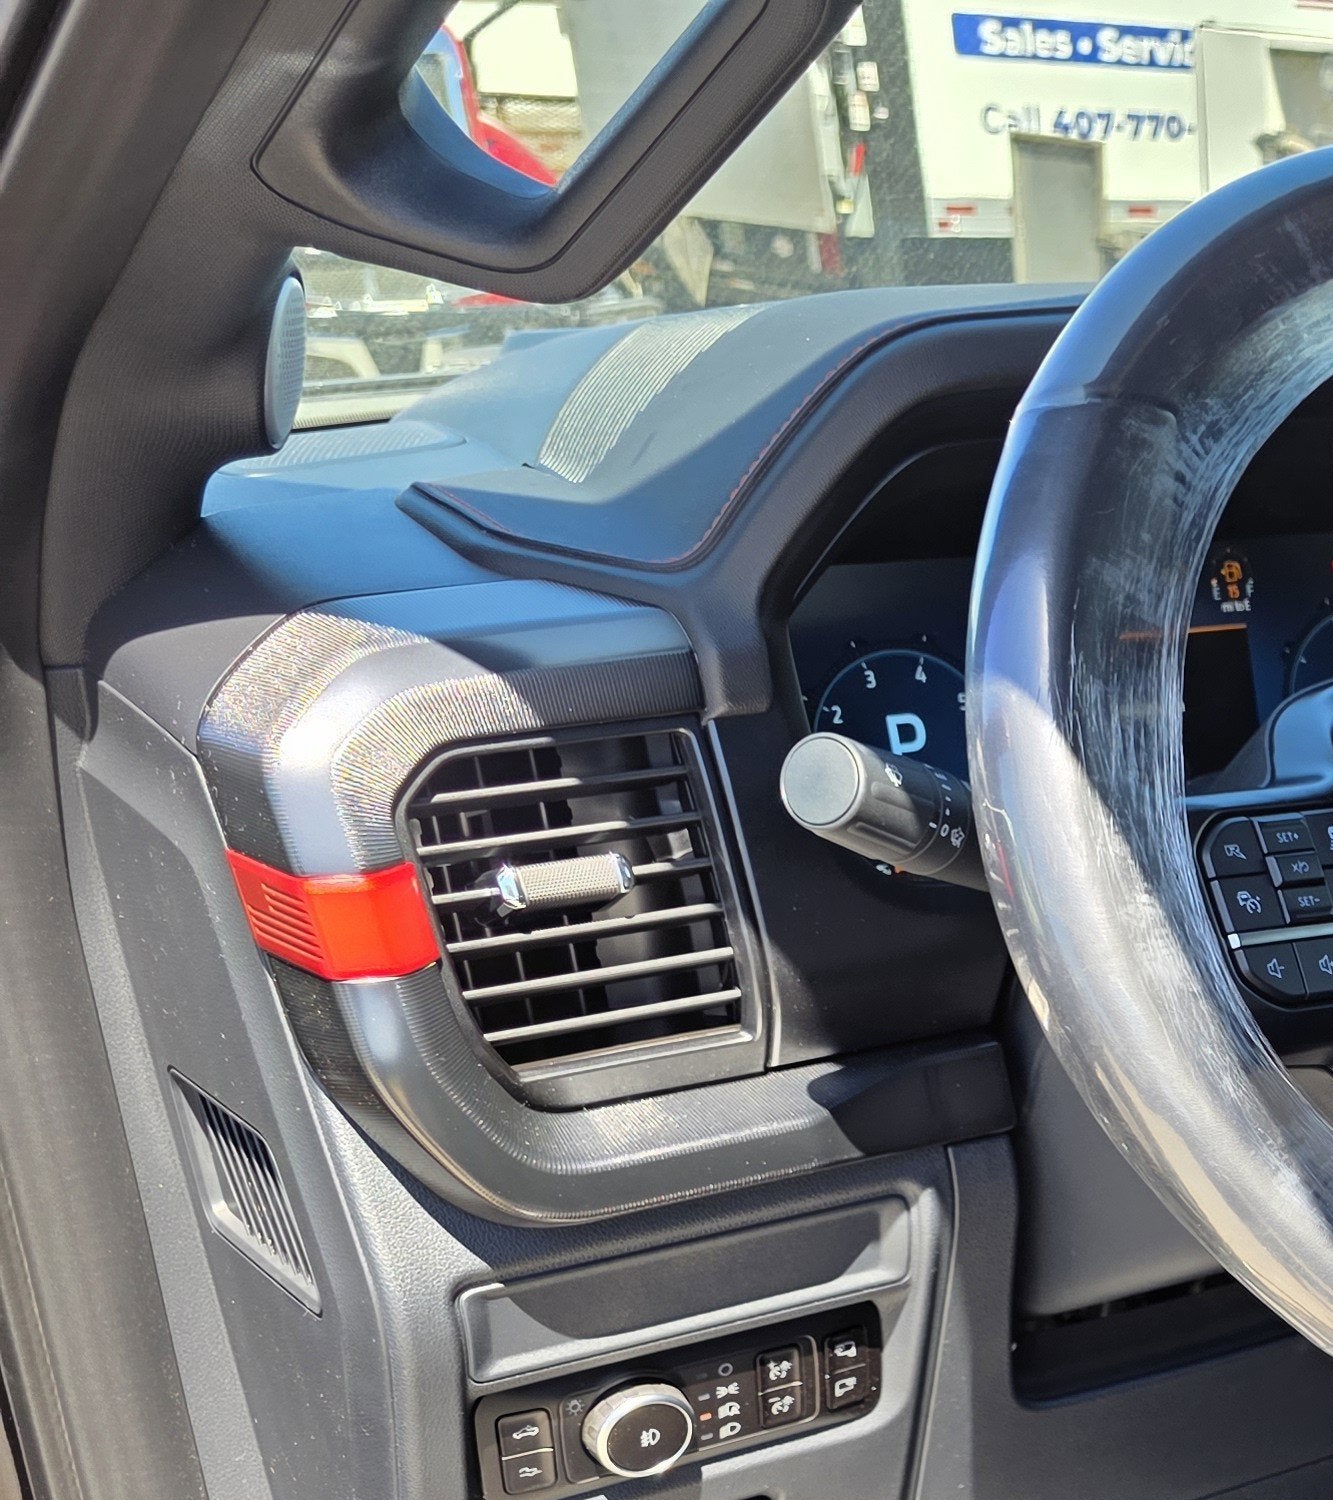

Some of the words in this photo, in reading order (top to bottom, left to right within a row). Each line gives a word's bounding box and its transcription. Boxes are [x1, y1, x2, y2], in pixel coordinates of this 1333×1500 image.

[977, 17, 1073, 60] Sales
[981, 102, 1041, 134] Call
[863, 669, 877, 689] 3
[914, 665, 927, 684] 4
[831, 704, 844, 724] 2
[885, 712, 927, 756] P
